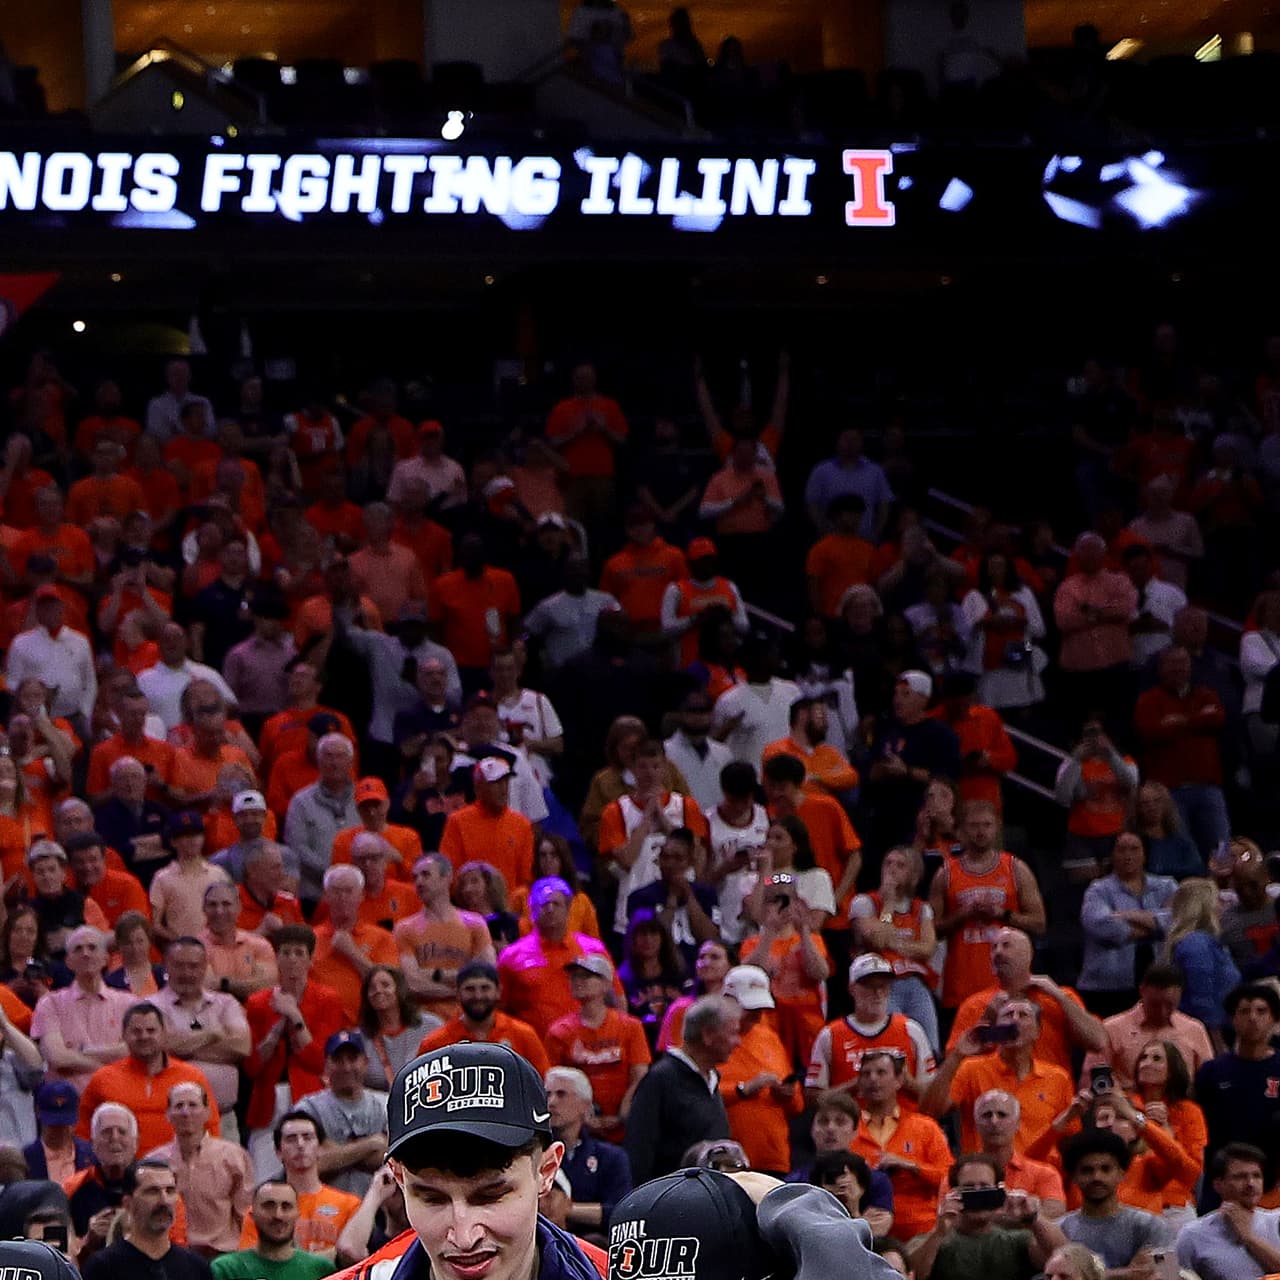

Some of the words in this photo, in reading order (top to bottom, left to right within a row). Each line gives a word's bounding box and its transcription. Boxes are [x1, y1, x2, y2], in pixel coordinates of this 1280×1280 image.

[200, 153, 562, 214] FIGHTING
[580, 156, 816, 216] ILLINI
[405, 1056, 453, 1092] FINAL
[611, 1220, 648, 1239] FINAL
